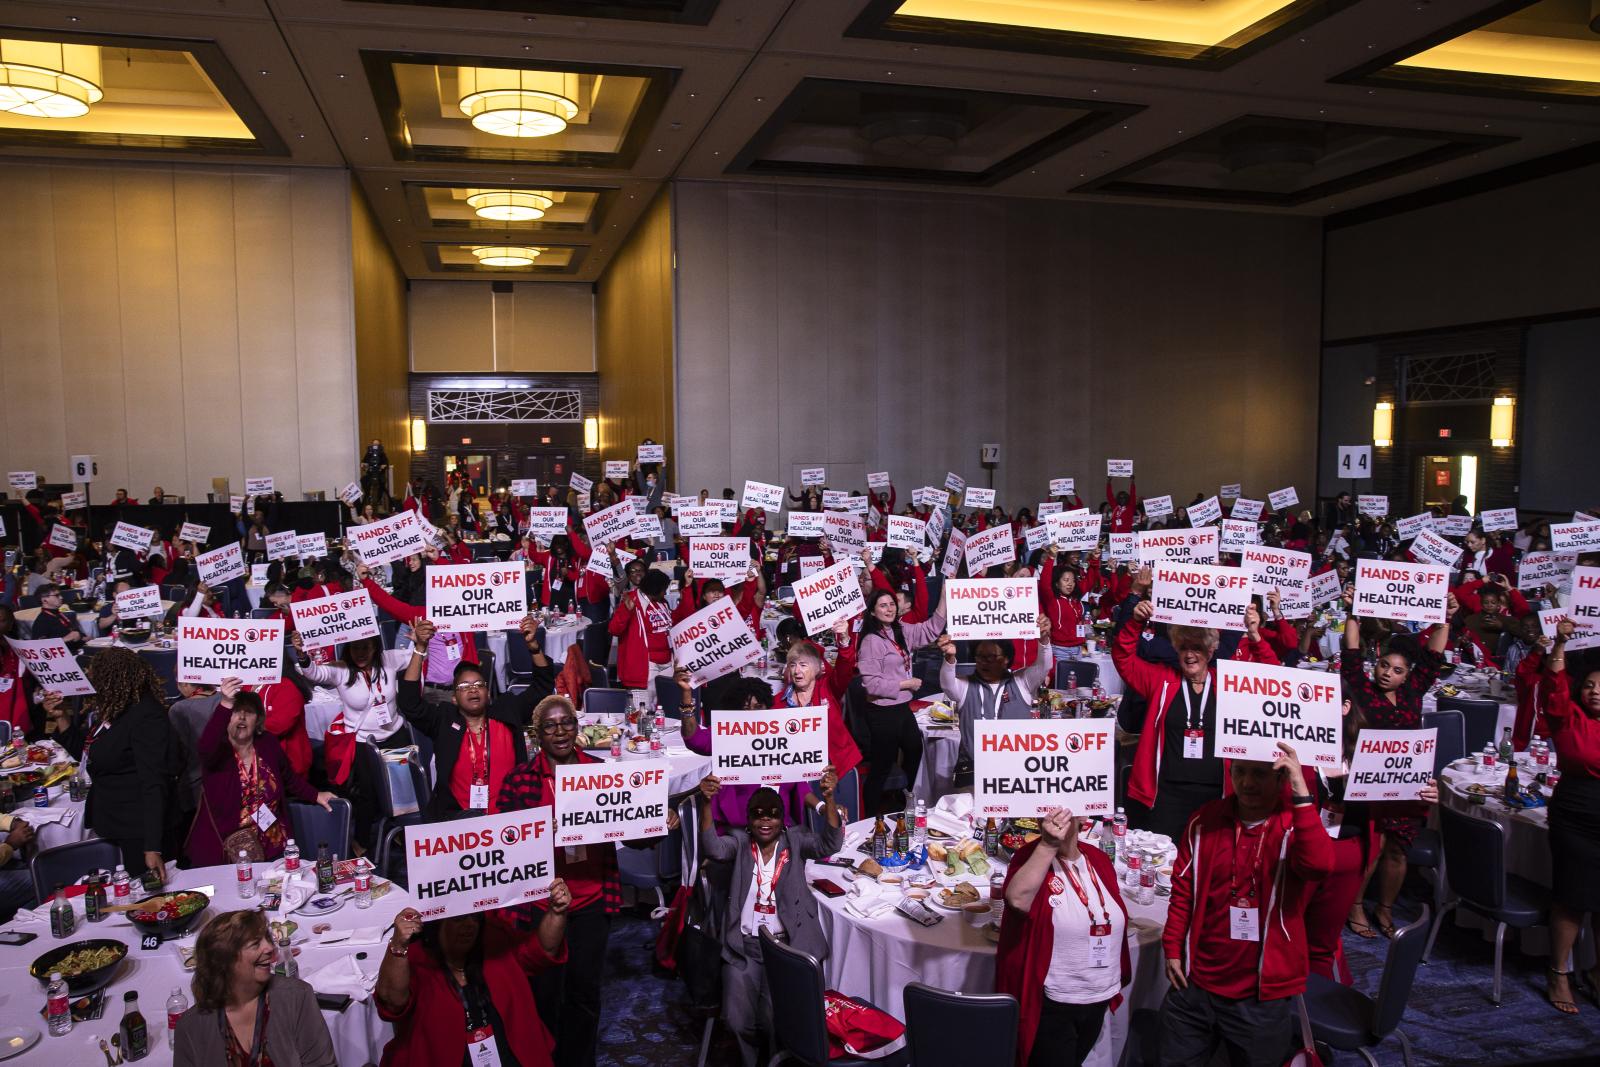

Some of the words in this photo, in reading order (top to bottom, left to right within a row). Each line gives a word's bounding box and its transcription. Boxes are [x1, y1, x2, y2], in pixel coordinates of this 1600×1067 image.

[991, 448, 998, 457] 7
[77, 462, 85, 476] 6
[746, 484, 768, 493] HANDS
[1188, 504, 1207, 515] HANDS
[586, 512, 613, 528] HANDS
[602, 517, 619, 528] OUR
[826, 515, 850, 527] HANDS
[890, 518, 913, 529] HANDS
[1059, 520, 1084, 528] HANDS
[357, 526, 390, 541] HANDS
[590, 517, 636, 541] HEALTHCARE
[838, 527, 852, 536] OUR
[378, 533, 398, 544] OUR
[824, 532, 864, 547] HEALTHCARE
[890, 533, 925, 543] HEALTHCARE
[966, 534, 989, 550] HANDS
[1057, 534, 1097, 543] HEALTHCARE
[1143, 536, 1184, 547] HANDS
[1421, 532, 1442, 547] HANDS
[364, 534, 421, 559] HEALTHCARE
[692, 542, 725, 551] HANDS
[979, 542, 994, 552] OUR
[1166, 548, 1190, 556] OUR
[1428, 544, 1442, 554] OUR
[198, 552, 224, 567] HANDS
[968, 545, 1012, 567] HEALTHCARE
[1246, 552, 1285, 565] HANDS
[1415, 542, 1451, 566] HEALTHCARE
[1523, 556, 1550, 565] HANDS
[202, 560, 242, 581] HEALTHCARE
[214, 559, 229, 569] OUR
[692, 560, 746, 568] HEALTHCARE
[1266, 566, 1288, 576] OUR
[432, 573, 486, 588] HANDS
[1158, 570, 1210, 586] HANDS
[1253, 574, 1303, 588] EALTHCARE
[1361, 567, 1410, 582] HANDS
[1522, 569, 1568, 581] HEALTHCARE
[797, 575, 836, 598] HANDS
[824, 585, 844, 601] OUR
[950, 586, 999, 599] HANDS
[1184, 587, 1216, 600] OUR
[1386, 582, 1415, 594] OUR
[116, 592, 140, 602] HANDS
[461, 588, 494, 601] OUR
[1359, 591, 1442, 609] HEALTHCARE
[295, 602, 338, 620] HANDS
[432, 599, 522, 617] HEALTHCARE
[806, 588, 861, 624] HEALTHCARE
[977, 600, 1007, 612] OUR
[1156, 596, 1245, 616] HEALTHCARE
[321, 612, 347, 624] OUR
[952, 612, 1034, 625] HEALTHCARE
[183, 628, 240, 641] HANDS
[301, 616, 372, 639] HEALTHCARE
[673, 622, 707, 648] HANDS
[212, 643, 246, 655] OUR
[695, 634, 720, 652] OUR
[28, 662, 52, 672] OUR
[182, 656, 277, 669] HEALTHCARE
[1224, 673, 1292, 698] HANDS
[1261, 700, 1301, 720] OUR
[717, 720, 780, 736] HANDS
[1223, 716, 1336, 743] HEALTHCARE
[751, 736, 788, 751] OUR
[982, 733, 1059, 752] HANDS
[1360, 740, 1409, 753] HANDS
[718, 750, 822, 768] HEALTHCARE
[1024, 755, 1069, 773] OUR
[1384, 757, 1412, 768] OUR
[562, 773, 624, 792] HANDS
[982, 774, 1108, 794] HEALTHCARE
[595, 790, 632, 806] OUR
[561, 803, 663, 826] HEALTHCARE
[415, 829, 494, 858] HANDS
[458, 849, 506, 871] OUR
[417, 860, 548, 898] HEALTHCARE
[143, 936, 157, 947] 46
